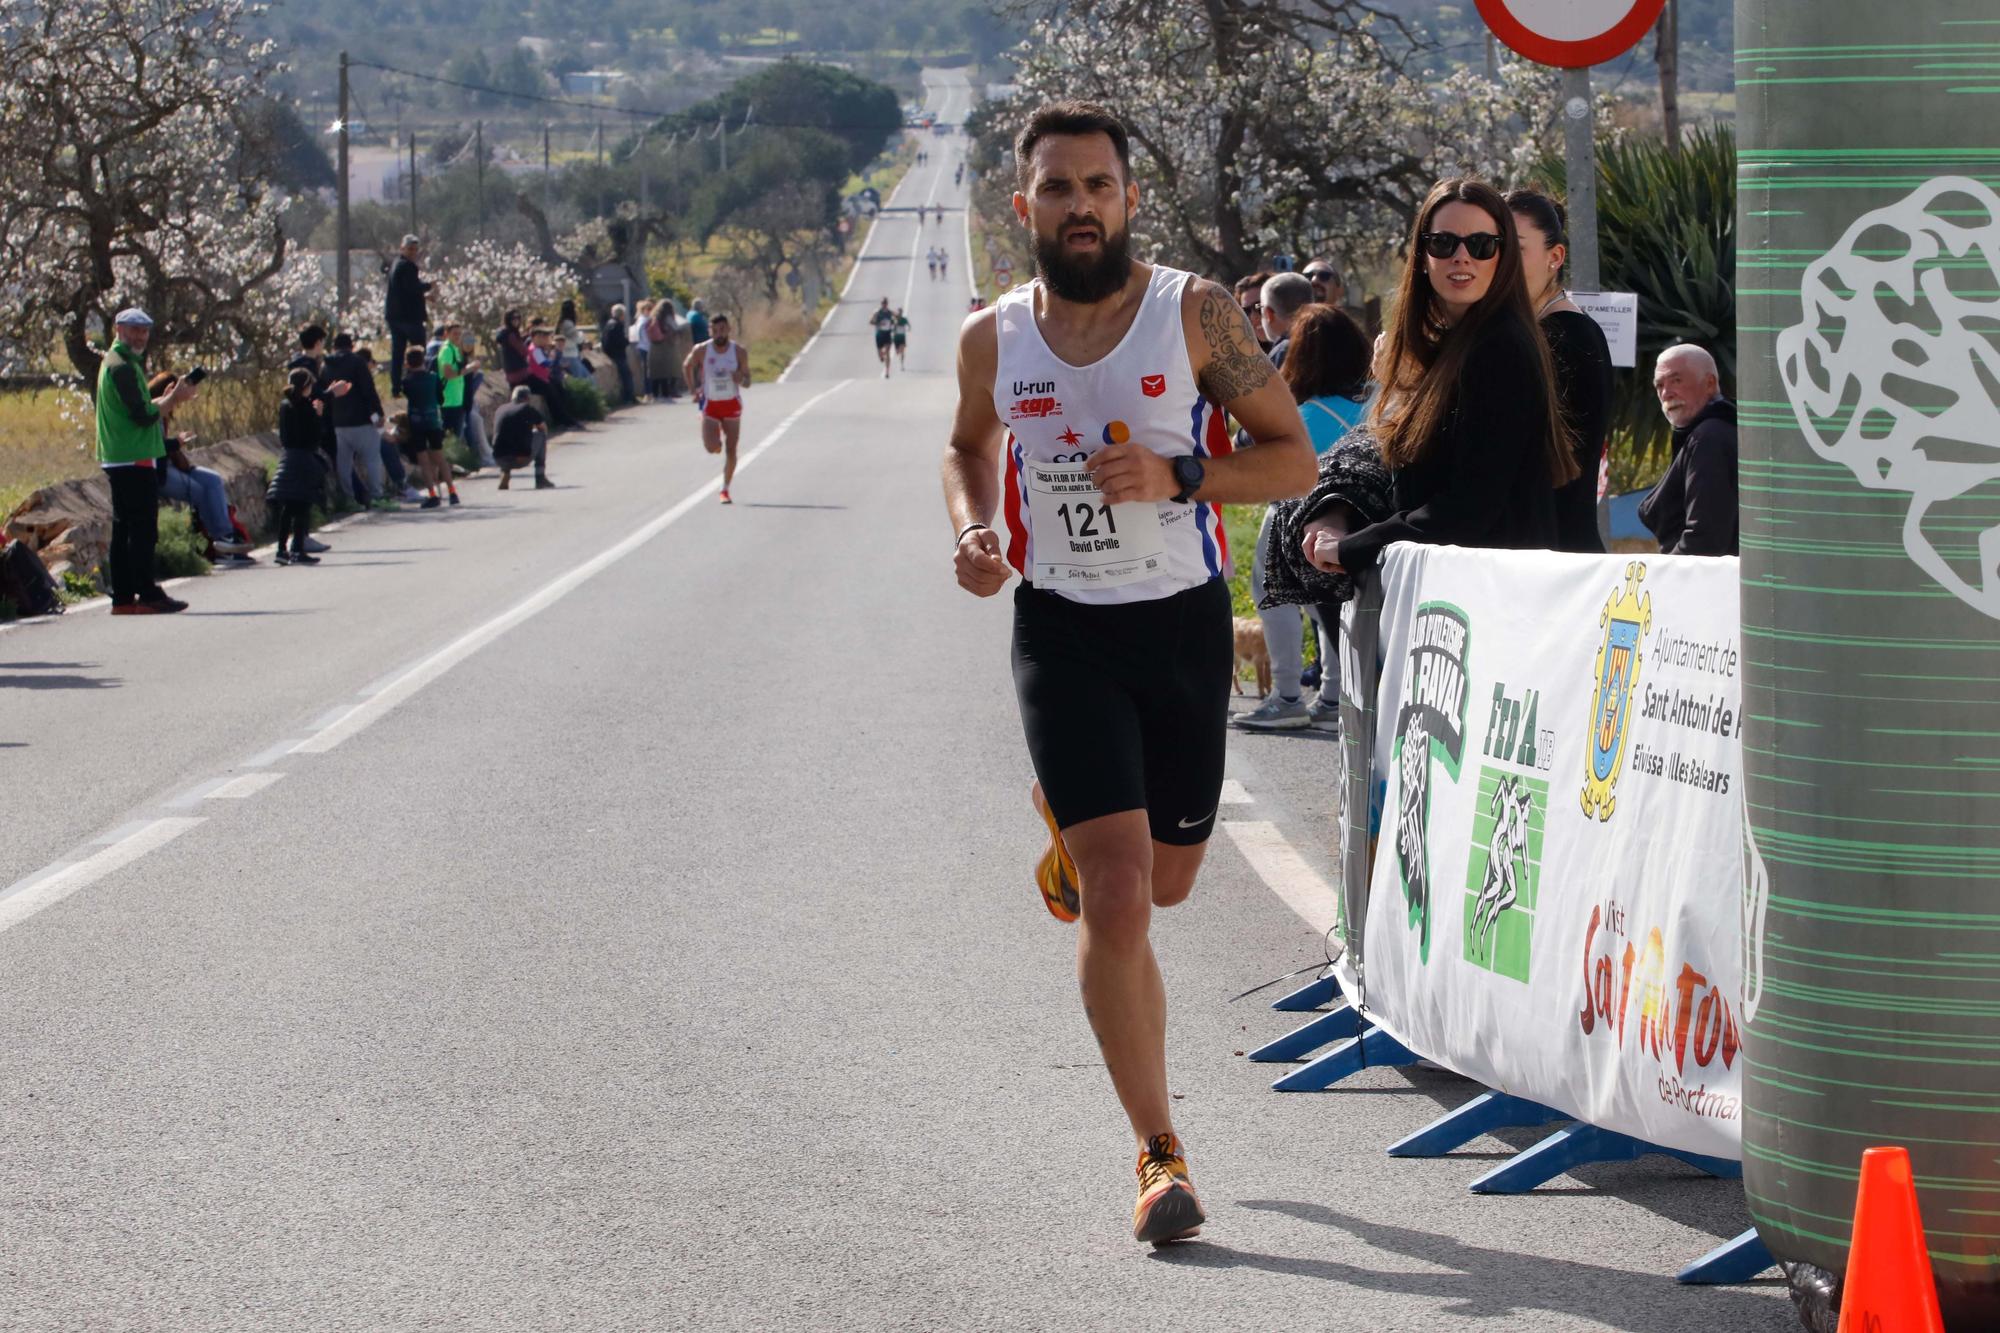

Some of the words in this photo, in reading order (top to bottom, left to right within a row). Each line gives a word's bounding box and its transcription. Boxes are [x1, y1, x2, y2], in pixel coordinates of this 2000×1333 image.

[1013, 381, 1055, 396] U-run
[1053, 473, 1070, 483] FLOR
[1057, 503, 1117, 537] 121
[1069, 540, 1093, 553] David
[1094, 538, 1120, 552] Grille
[1651, 626, 1719, 674] Ajuntament
[1719, 638, 1737, 678] de
[1417, 651, 1465, 737] RAVAL
[1641, 682, 1670, 722] Sant
[1669, 688, 1714, 732] Antoni
[1711, 696, 1733, 738] de
[1632, 743, 1664, 777] Eivissa
[1667, 751, 1690, 783] Illes
[1688, 758, 1730, 795] Balears
[1658, 1069, 1673, 1105] de
